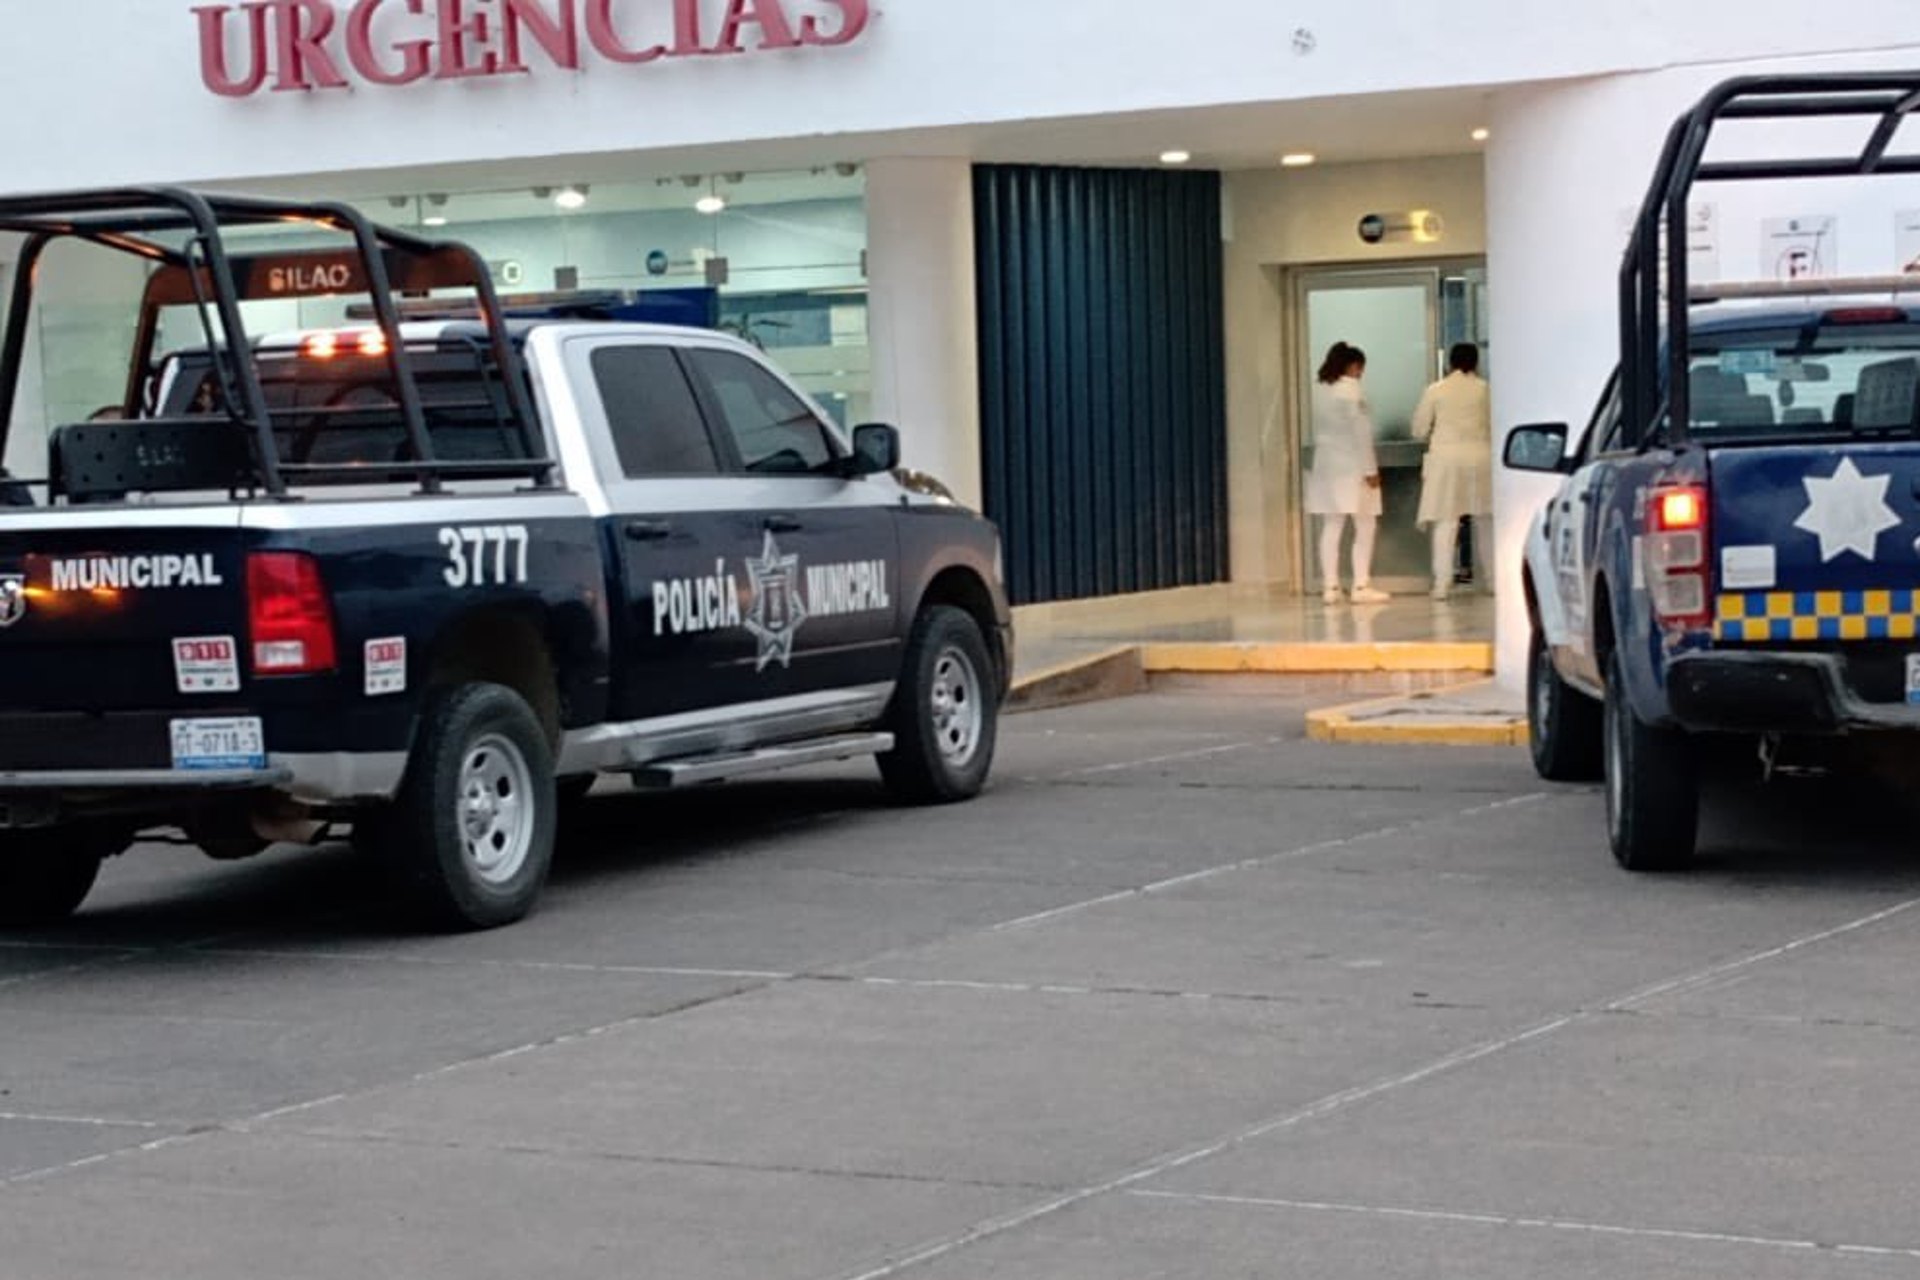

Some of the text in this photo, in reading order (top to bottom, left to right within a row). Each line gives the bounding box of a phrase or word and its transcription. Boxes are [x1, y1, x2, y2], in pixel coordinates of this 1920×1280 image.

[190, 0, 871, 97] URGENCIAS
[269, 264, 350, 291] SILAO
[51, 553, 223, 591] MUNICIPAL
[438, 525, 528, 588] 3777
[653, 557, 889, 635] POLICÍA MUNICIPAL
